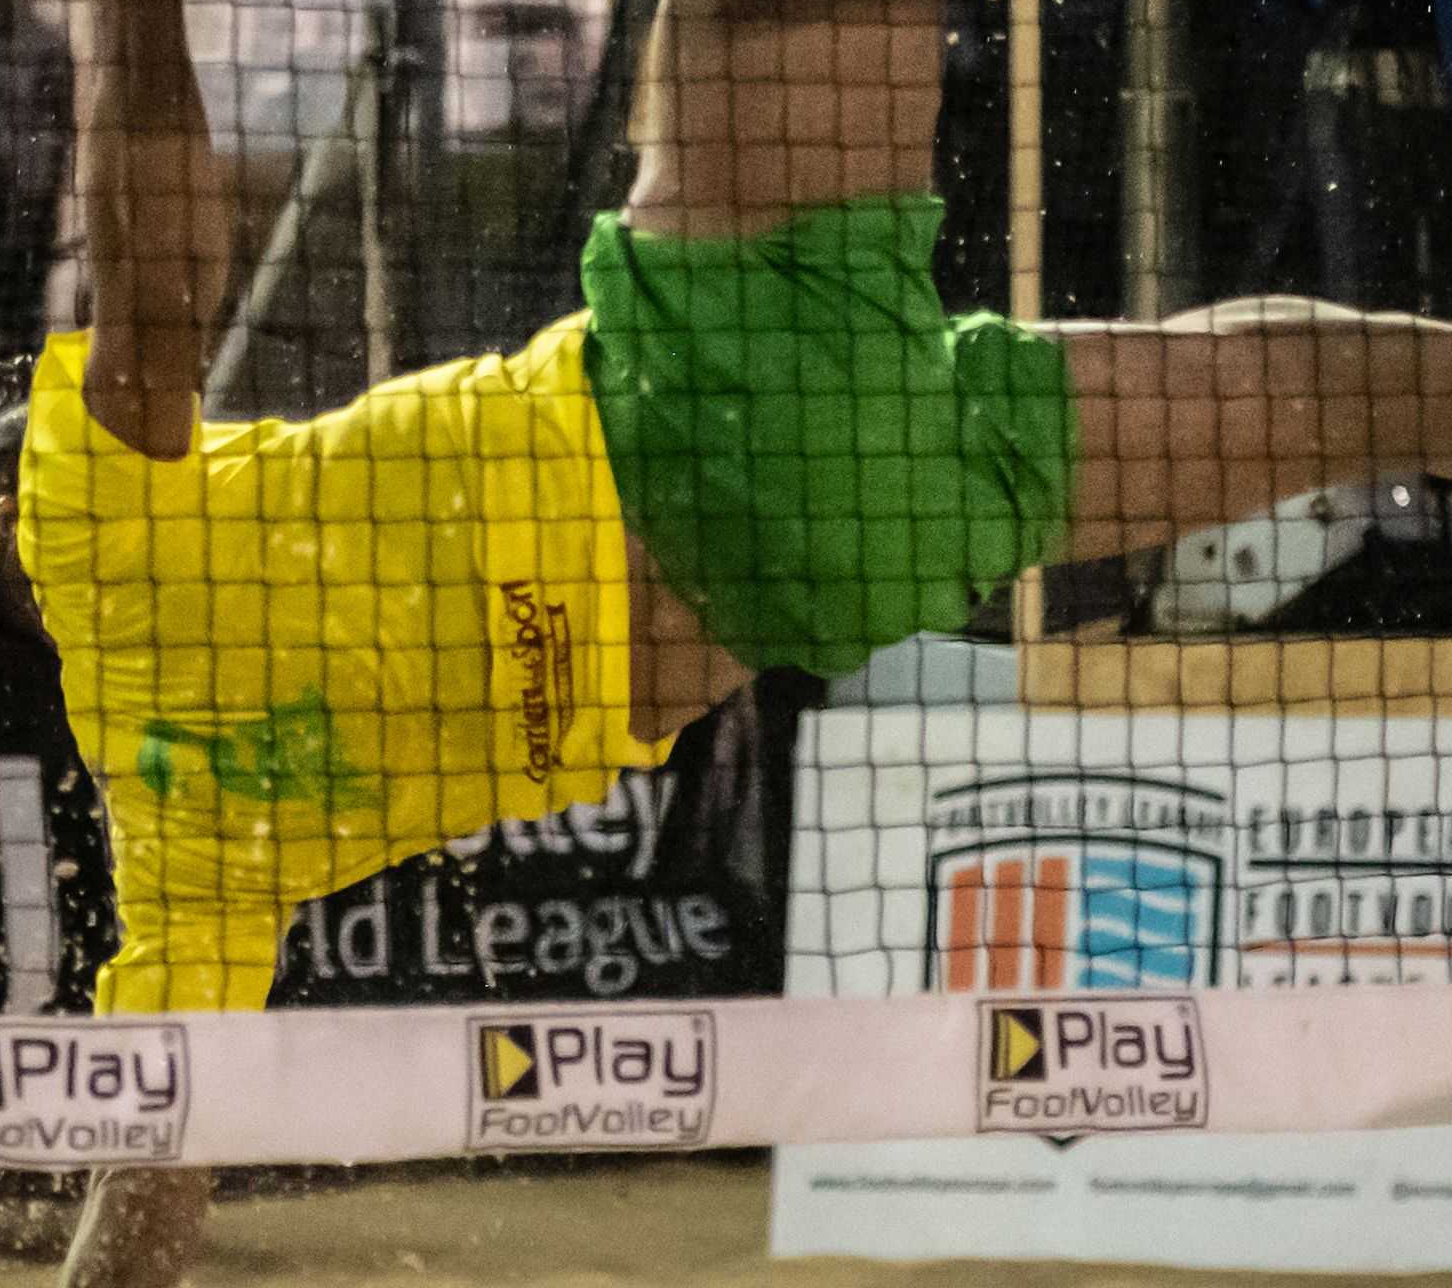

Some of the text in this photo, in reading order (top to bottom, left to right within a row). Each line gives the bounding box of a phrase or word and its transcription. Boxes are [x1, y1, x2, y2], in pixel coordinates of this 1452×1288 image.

[421, 874, 732, 996] League
[11, 1037, 177, 1113] Play
[547, 1025, 705, 1098] Play
[1055, 1011, 1195, 1082] Play
